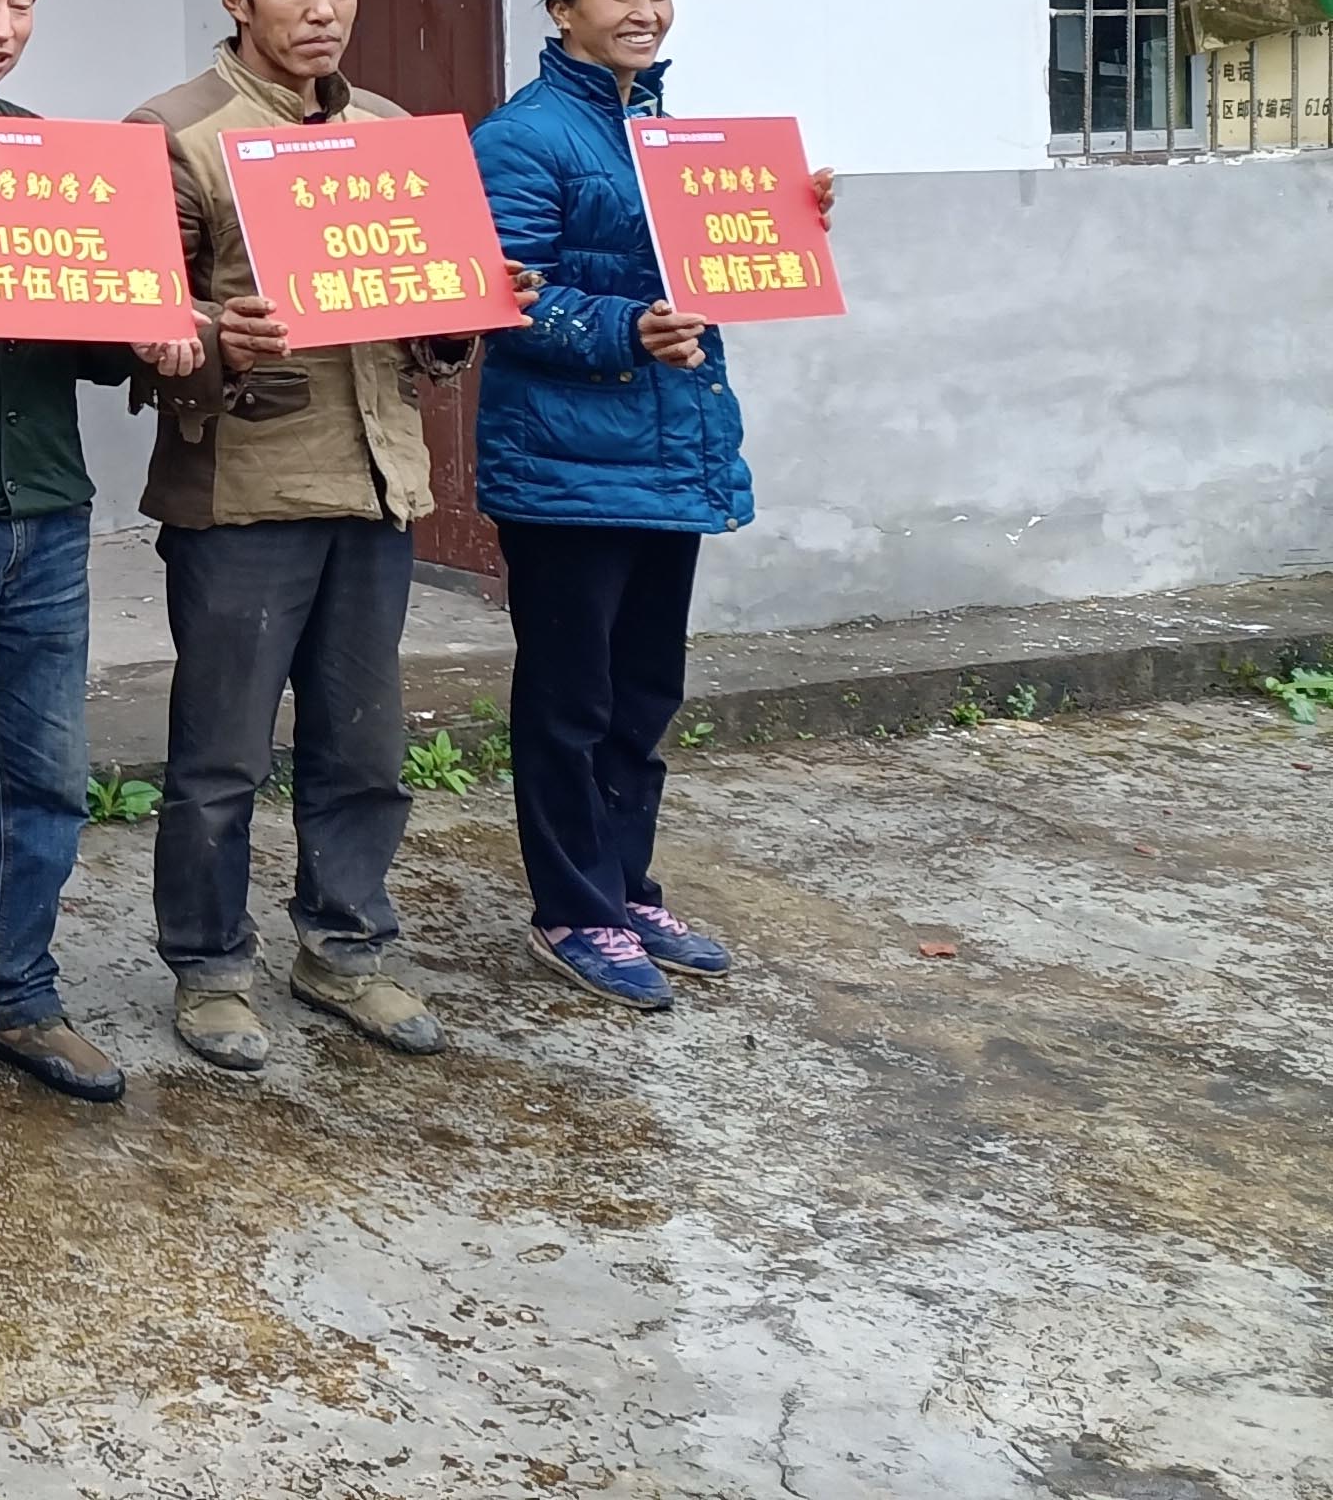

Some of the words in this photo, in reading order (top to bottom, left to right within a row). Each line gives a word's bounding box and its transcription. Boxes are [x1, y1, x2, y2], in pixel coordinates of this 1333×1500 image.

[290, 169, 430, 209] 高中助学金
[680, 165, 779, 197] 高中助学金
[323, 217, 428, 259] 800元
[705, 210, 779, 246] 800元
